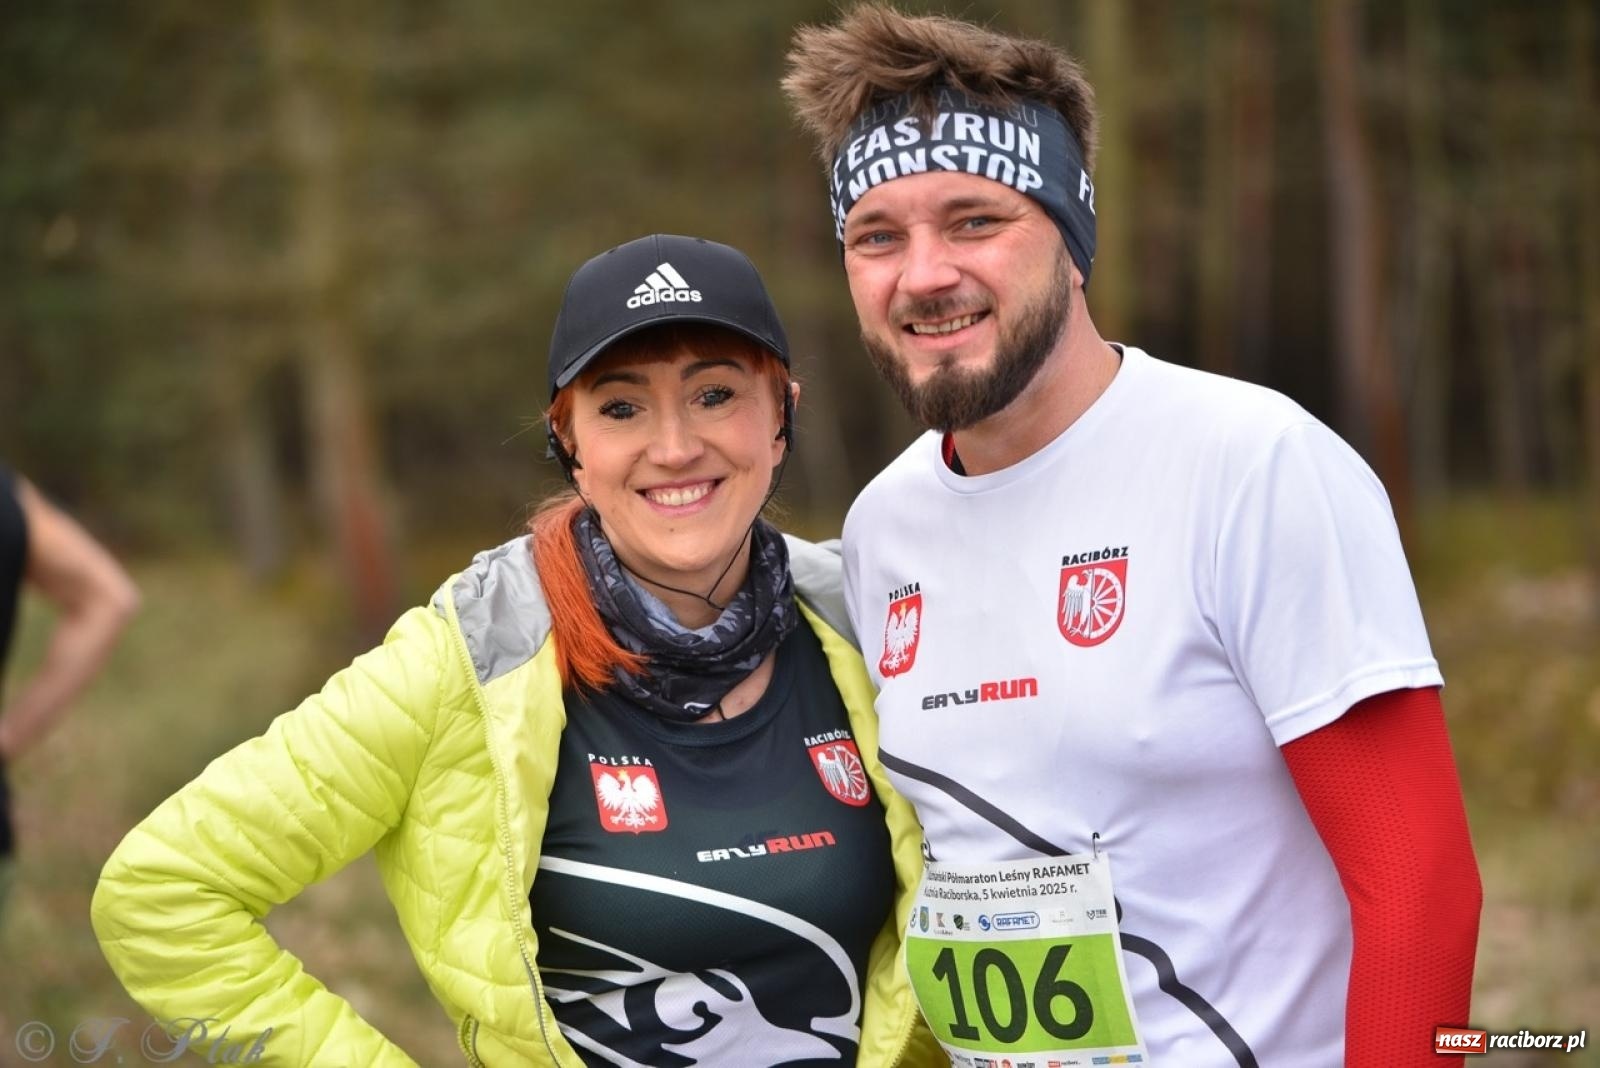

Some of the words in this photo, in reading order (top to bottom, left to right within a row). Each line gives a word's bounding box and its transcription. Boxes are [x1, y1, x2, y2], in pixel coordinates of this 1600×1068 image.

[847, 112, 1041, 172] EASYRUN
[849, 144, 1043, 201] NONSTOP
[626, 287, 703, 309] adidas
[1061, 546, 1129, 566] RACIBÓRZ
[888, 582, 921, 602] POLSKA
[588, 753, 654, 767] POLSKA
[947, 871, 997, 884] Półmaraton
[998, 868, 1031, 884] Leśny
[1033, 863, 1090, 878] RAFAMET
[982, 888, 989, 900] 5
[990, 884, 1037, 900] kwietnia
[1039, 882, 1068, 896] 2025
[1069, 885, 1078, 894] r.
[932, 943, 1094, 1044] 106
